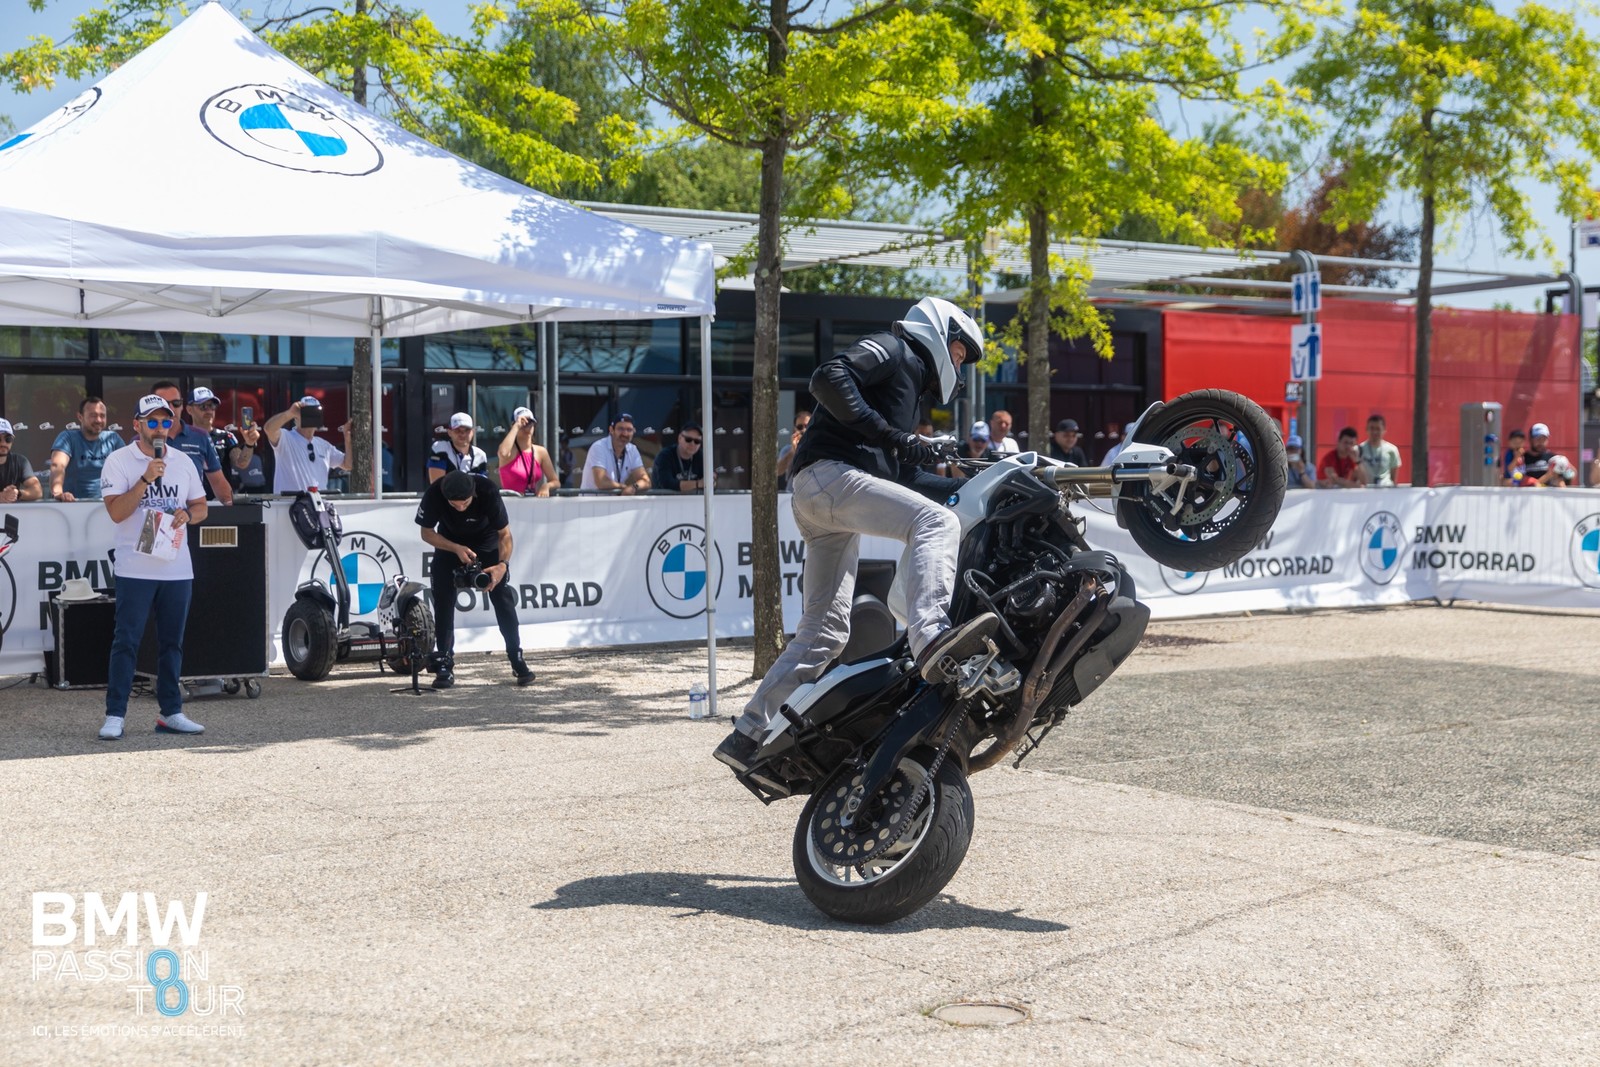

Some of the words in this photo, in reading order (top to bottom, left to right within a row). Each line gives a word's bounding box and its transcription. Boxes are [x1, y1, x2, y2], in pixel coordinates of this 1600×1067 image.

[215, 89, 334, 121] BMW
[1414, 524, 1467, 544] BMW
[738, 540, 805, 566] BW
[1412, 550, 1535, 572] MOTORRAD
[1223, 555, 1333, 578] MOTORRAD
